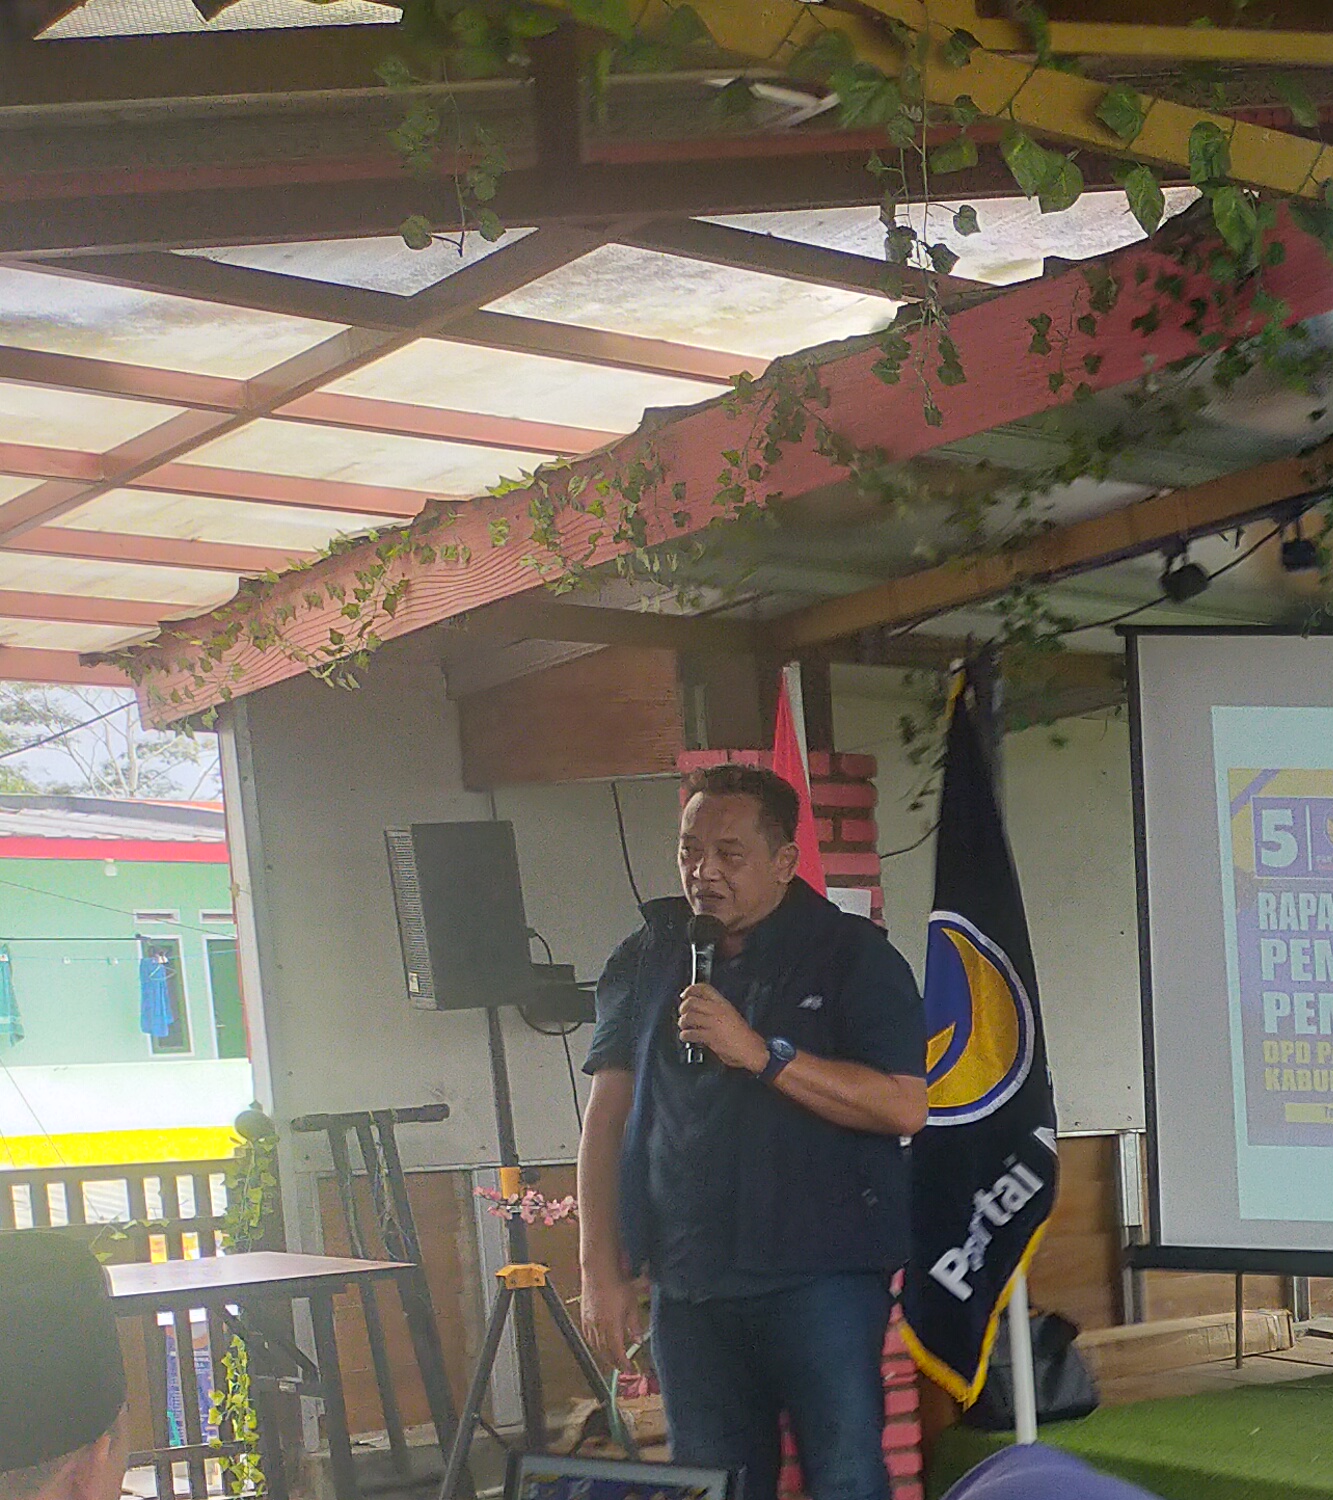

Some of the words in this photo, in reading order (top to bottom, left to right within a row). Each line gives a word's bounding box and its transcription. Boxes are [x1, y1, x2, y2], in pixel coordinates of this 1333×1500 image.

[1259, 809, 1298, 867] 5
[1263, 1040, 1311, 1065] DPD
[929, 1153, 1045, 1302] Partai
